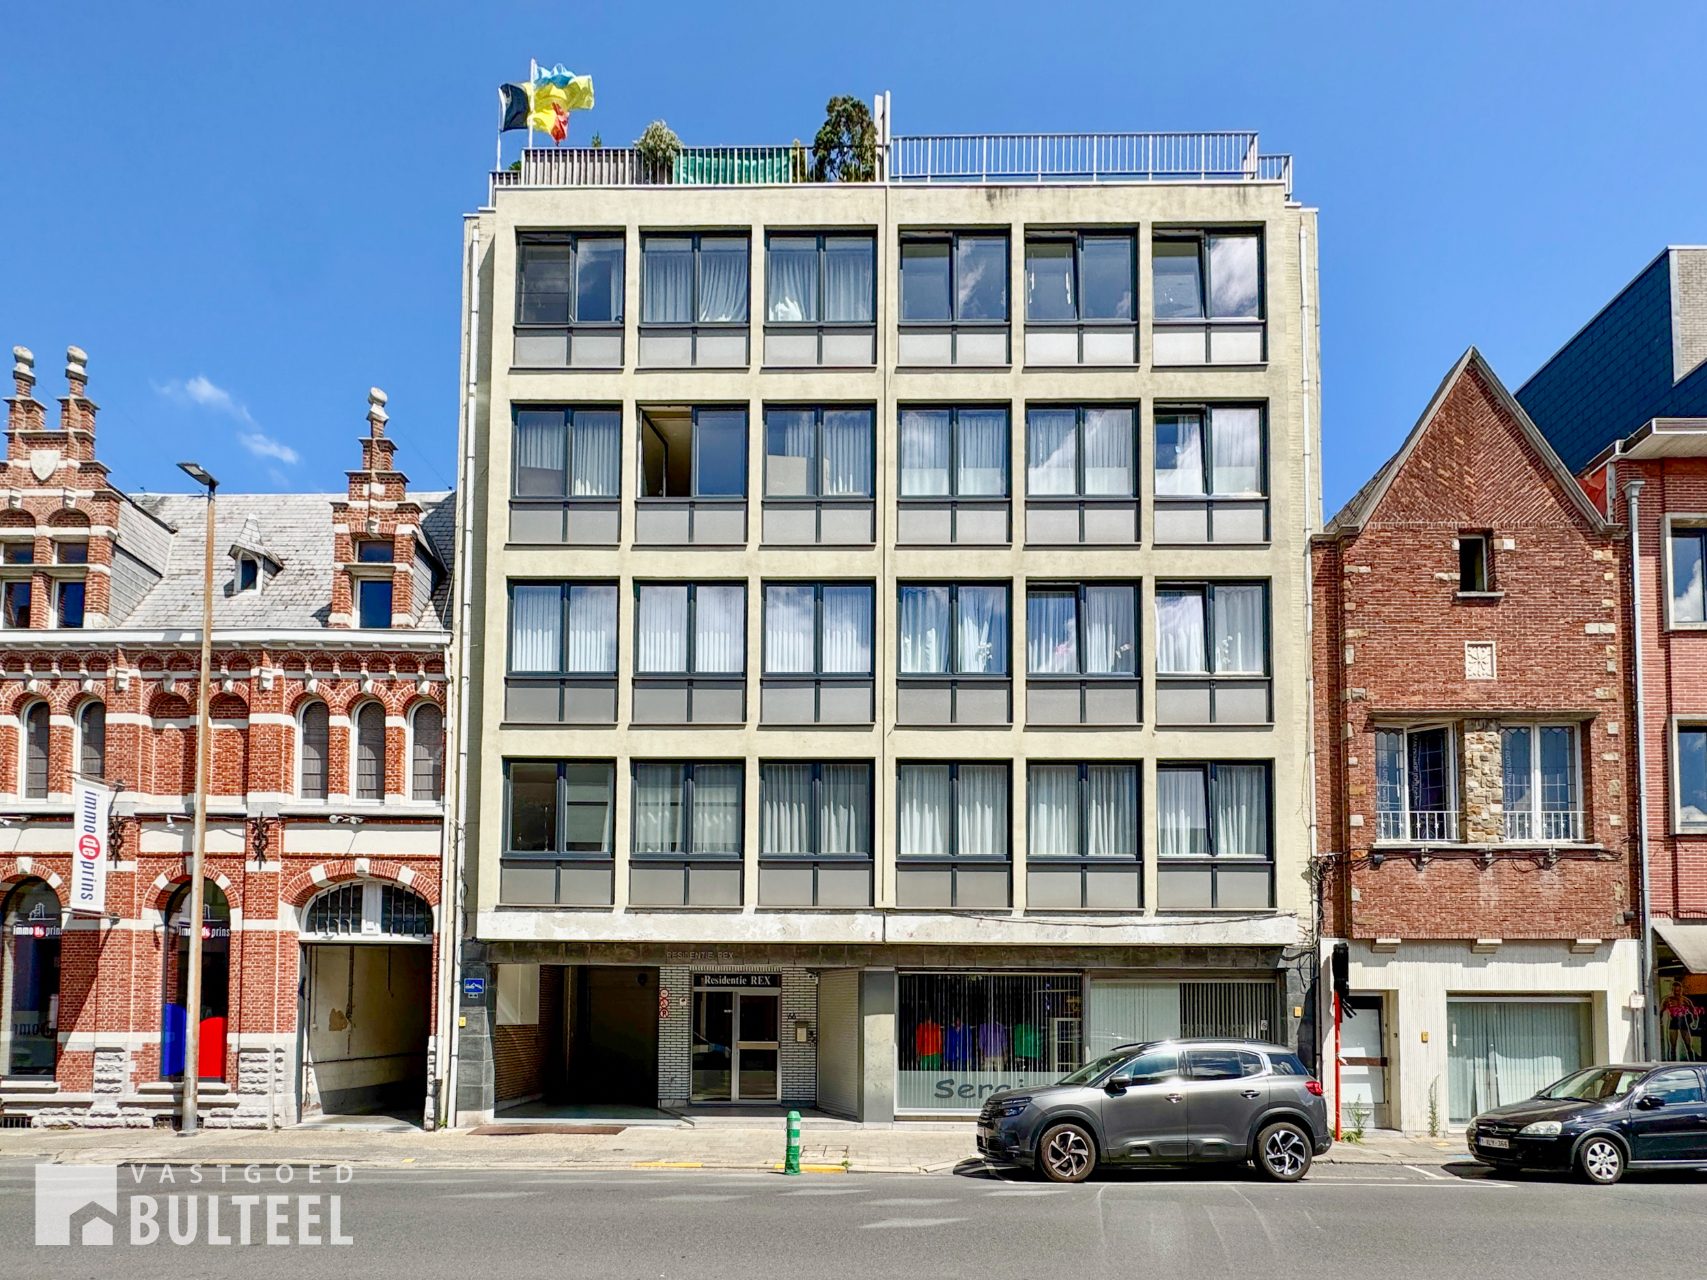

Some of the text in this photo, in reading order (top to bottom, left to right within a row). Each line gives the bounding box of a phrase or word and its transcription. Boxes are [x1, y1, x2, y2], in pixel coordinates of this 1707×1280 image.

[80, 790, 100, 901] immo de prins
[13, 925, 34, 935] immo
[211, 926, 231, 939] prins
[666, 951, 734, 960] RESIDENTIE REX
[704, 975, 771, 985] Residentie REX
